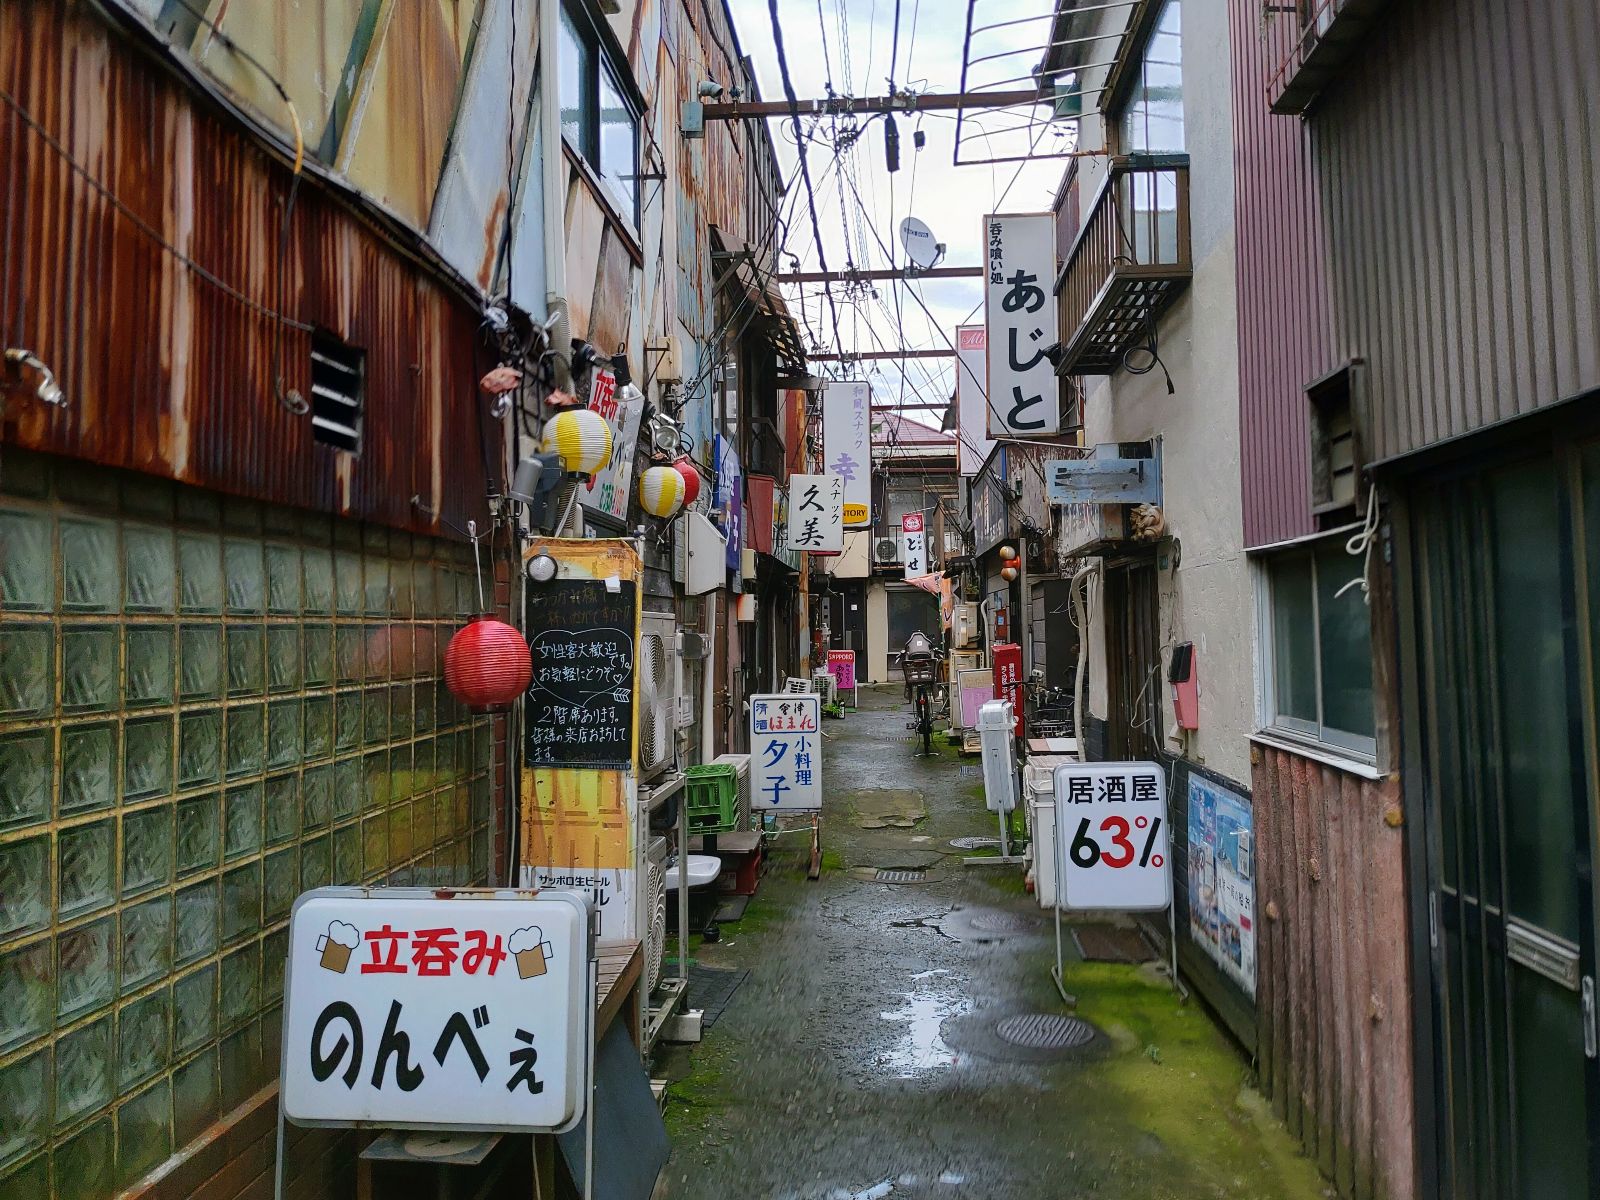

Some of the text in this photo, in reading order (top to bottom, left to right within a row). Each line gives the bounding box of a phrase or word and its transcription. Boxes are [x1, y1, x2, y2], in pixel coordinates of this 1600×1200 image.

[989, 222, 1004, 285] 呑み喰い処
[1001, 269, 1046, 430] あじと
[851, 386, 865, 449] 和風スナック
[829, 452, 860, 488] 幸
[795, 484, 825, 547] 久美
[830, 478, 841, 525] スナック
[755, 703, 768, 730] 清酒
[769, 714, 815, 732] ほまれ
[762, 739, 791, 805] 夕子
[794, 735, 812, 786] 小料理
[1067, 775, 1160, 805] 居酒屋
[1069, 815, 1164, 869] 63%
[539, 874, 611, 887] サッポロ生ビール
[360, 924, 507, 977] 立呑み
[310, 999, 544, 1095] のんべぇ
